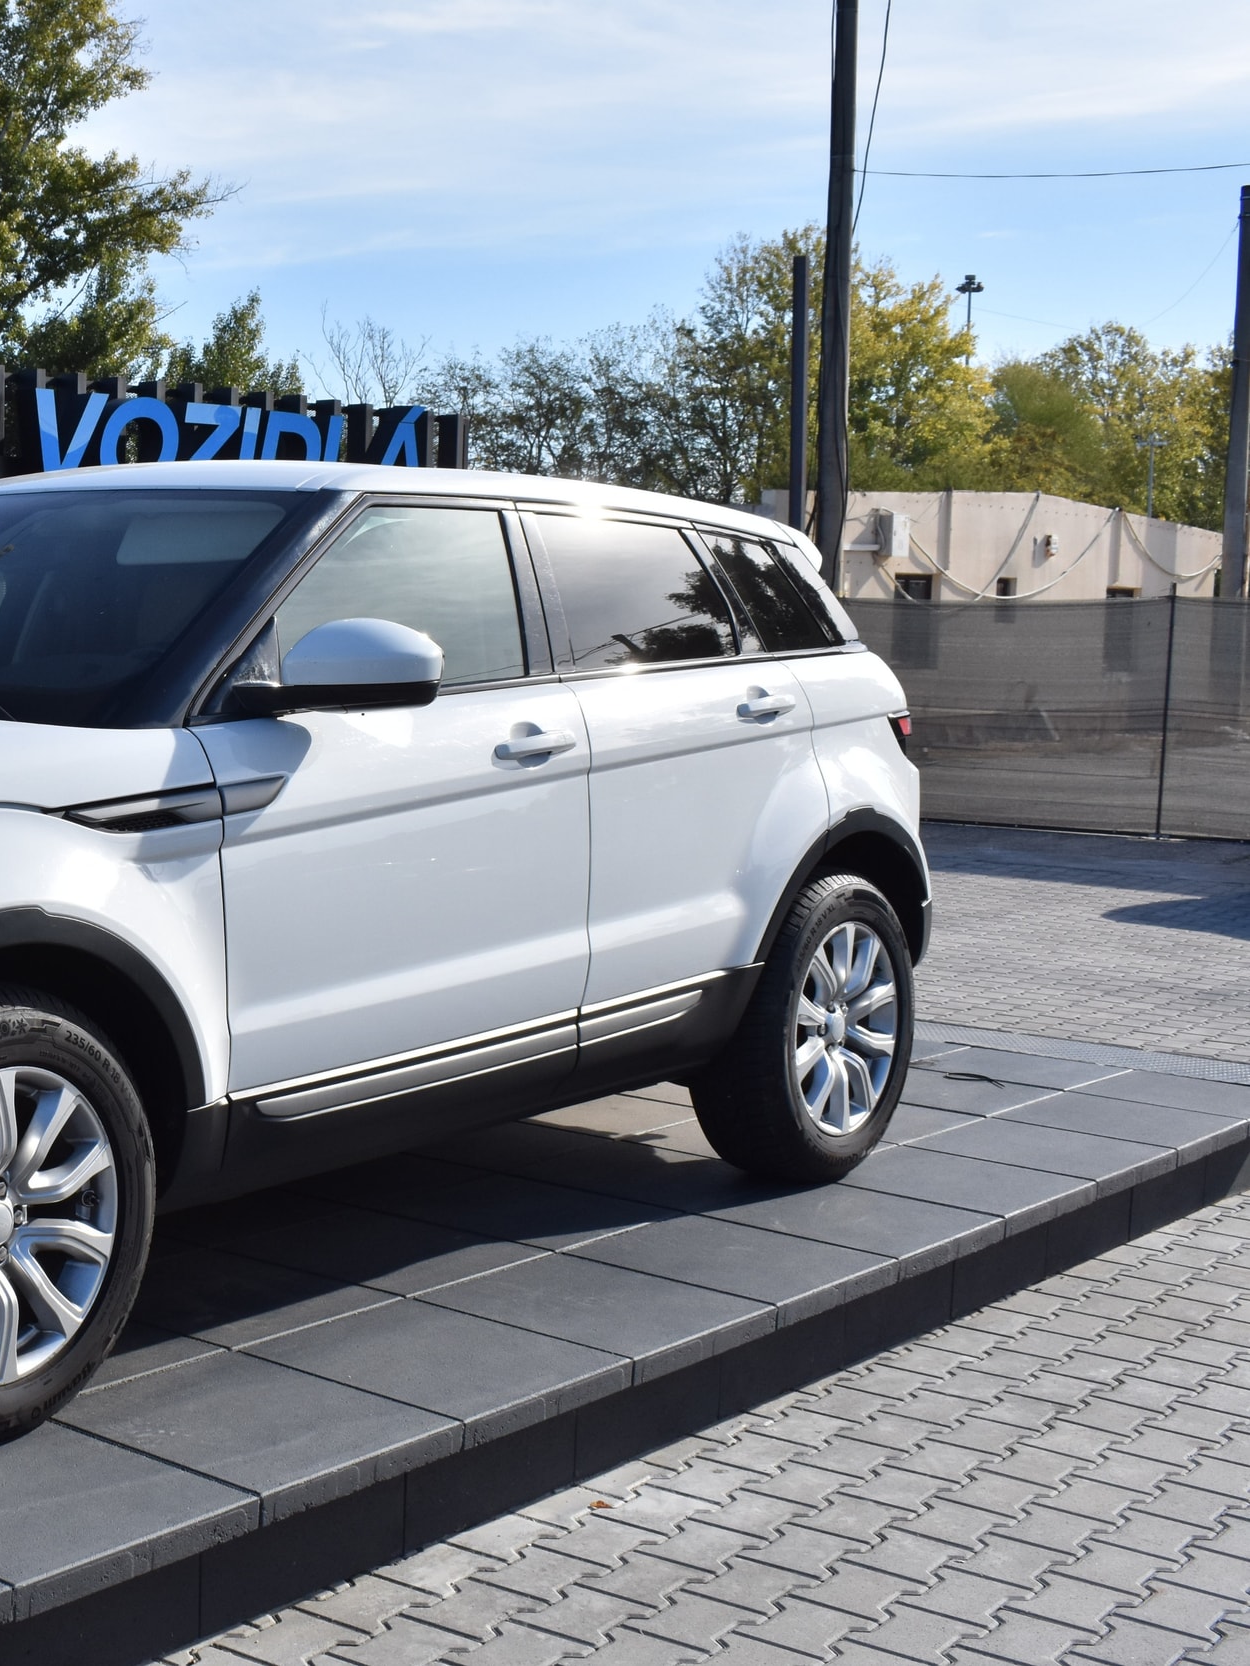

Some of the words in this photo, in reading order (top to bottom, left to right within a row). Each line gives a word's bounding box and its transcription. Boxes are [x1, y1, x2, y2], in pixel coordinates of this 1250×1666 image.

[64, 1029, 102, 1062] 235/60
[101, 1058, 111, 1073] R
[109, 1069, 122, 1084] 18
